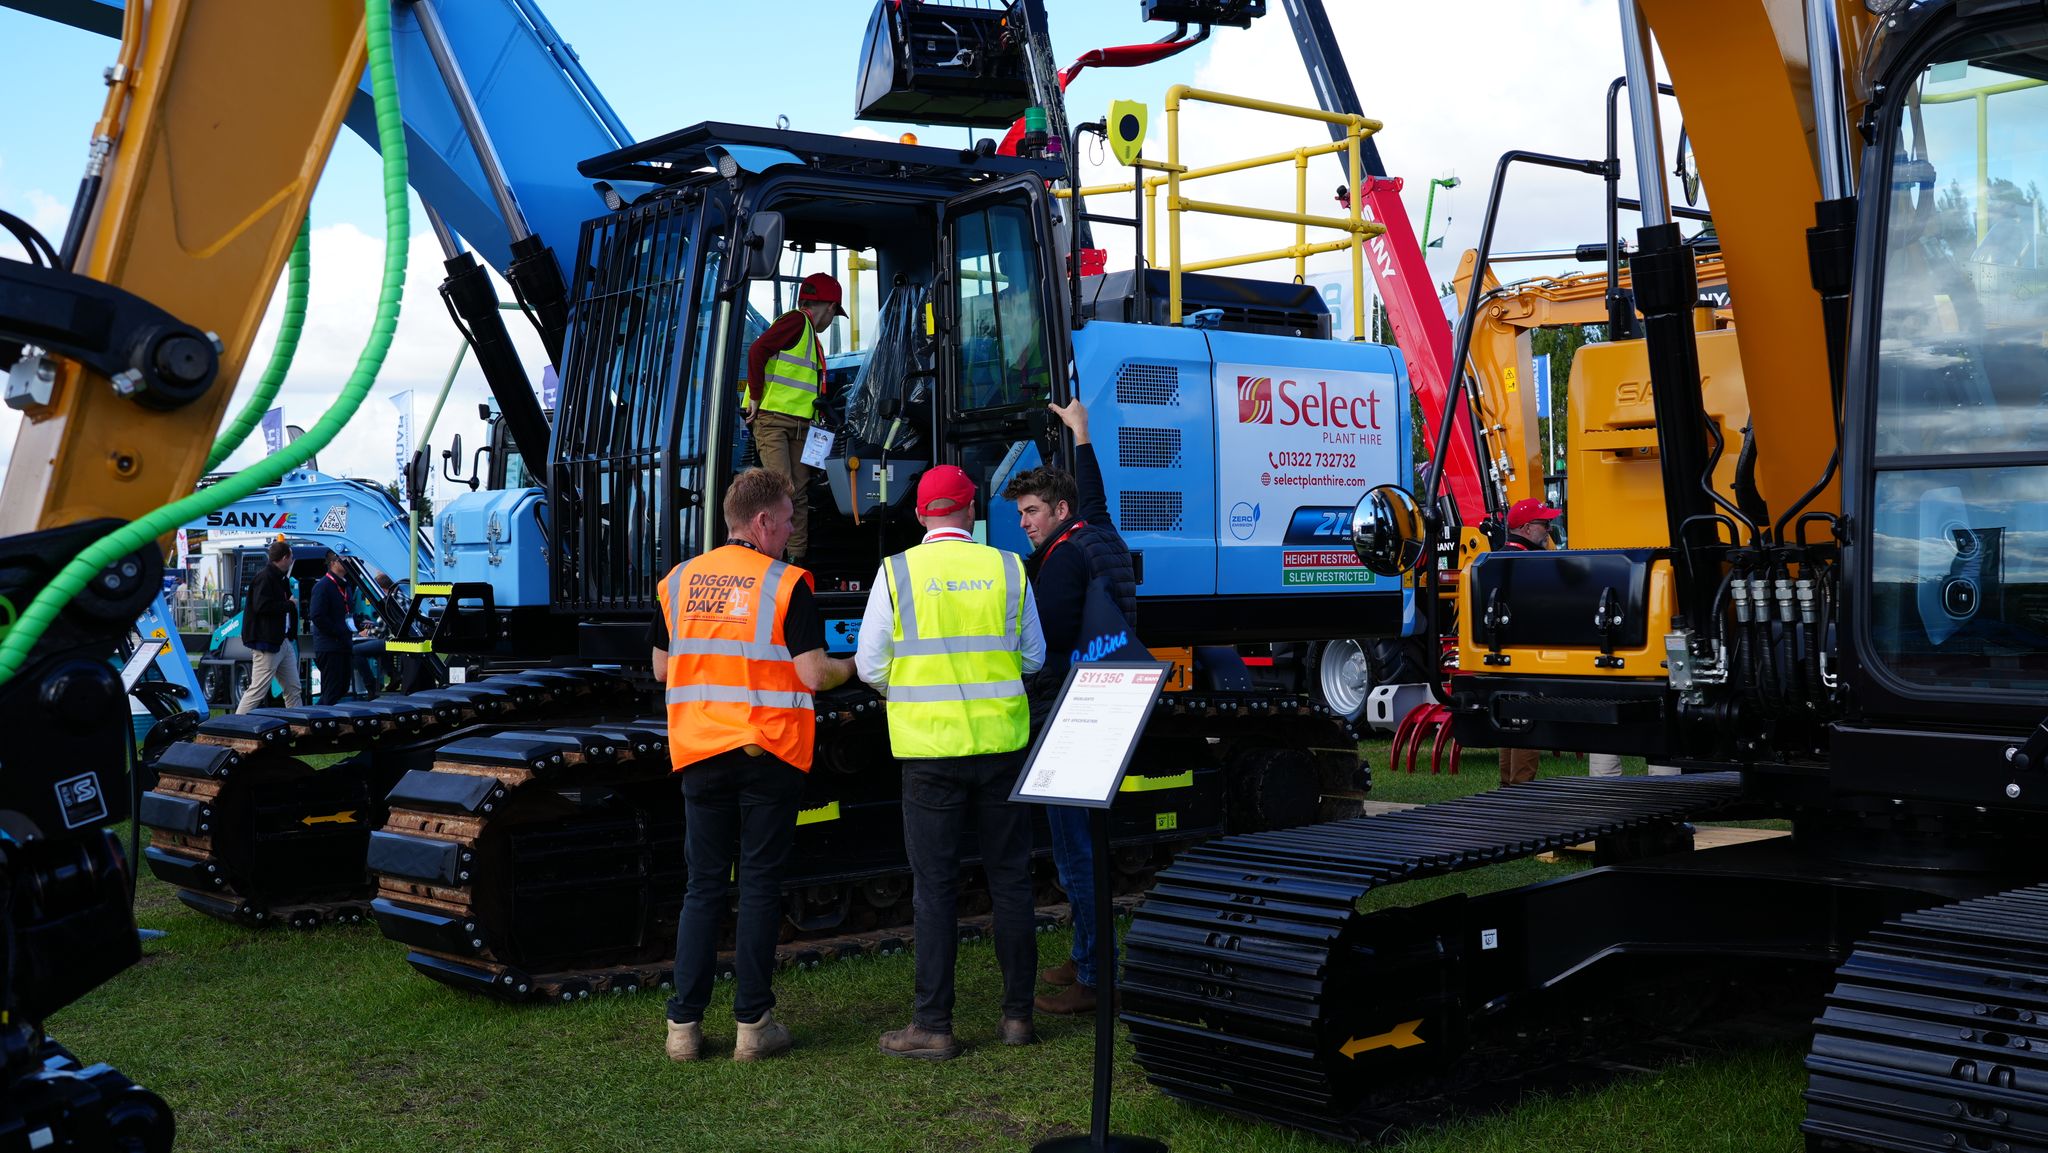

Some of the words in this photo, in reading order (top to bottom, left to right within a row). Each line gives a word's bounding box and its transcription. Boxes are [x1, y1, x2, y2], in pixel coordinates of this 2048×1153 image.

[1362, 204, 1396, 278] SNY
[1278, 380, 1381, 430] Select
[1323, 432, 1356, 444] PLANT
[1359, 434, 1382, 445] HIRE
[1279, 451, 1312, 467] 01322
[1315, 453, 1356, 468] 732732
[1274, 473, 1365, 489] selectplanthire.com
[206, 511, 276, 528] SANY
[1437, 542, 1455, 551] ANY
[1285, 554, 1318, 565] HEIGHT
[689, 573, 756, 589] DIGGING
[1289, 572, 1314, 583] SLEW
[1317, 572, 1369, 582] RESTRICTED
[946, 579, 994, 591] SANY
[689, 587, 732, 600] WITH
[685, 600, 727, 614] DAVE
[1070, 631, 1128, 663] Collins
[1079, 672, 1125, 684] SY135C
